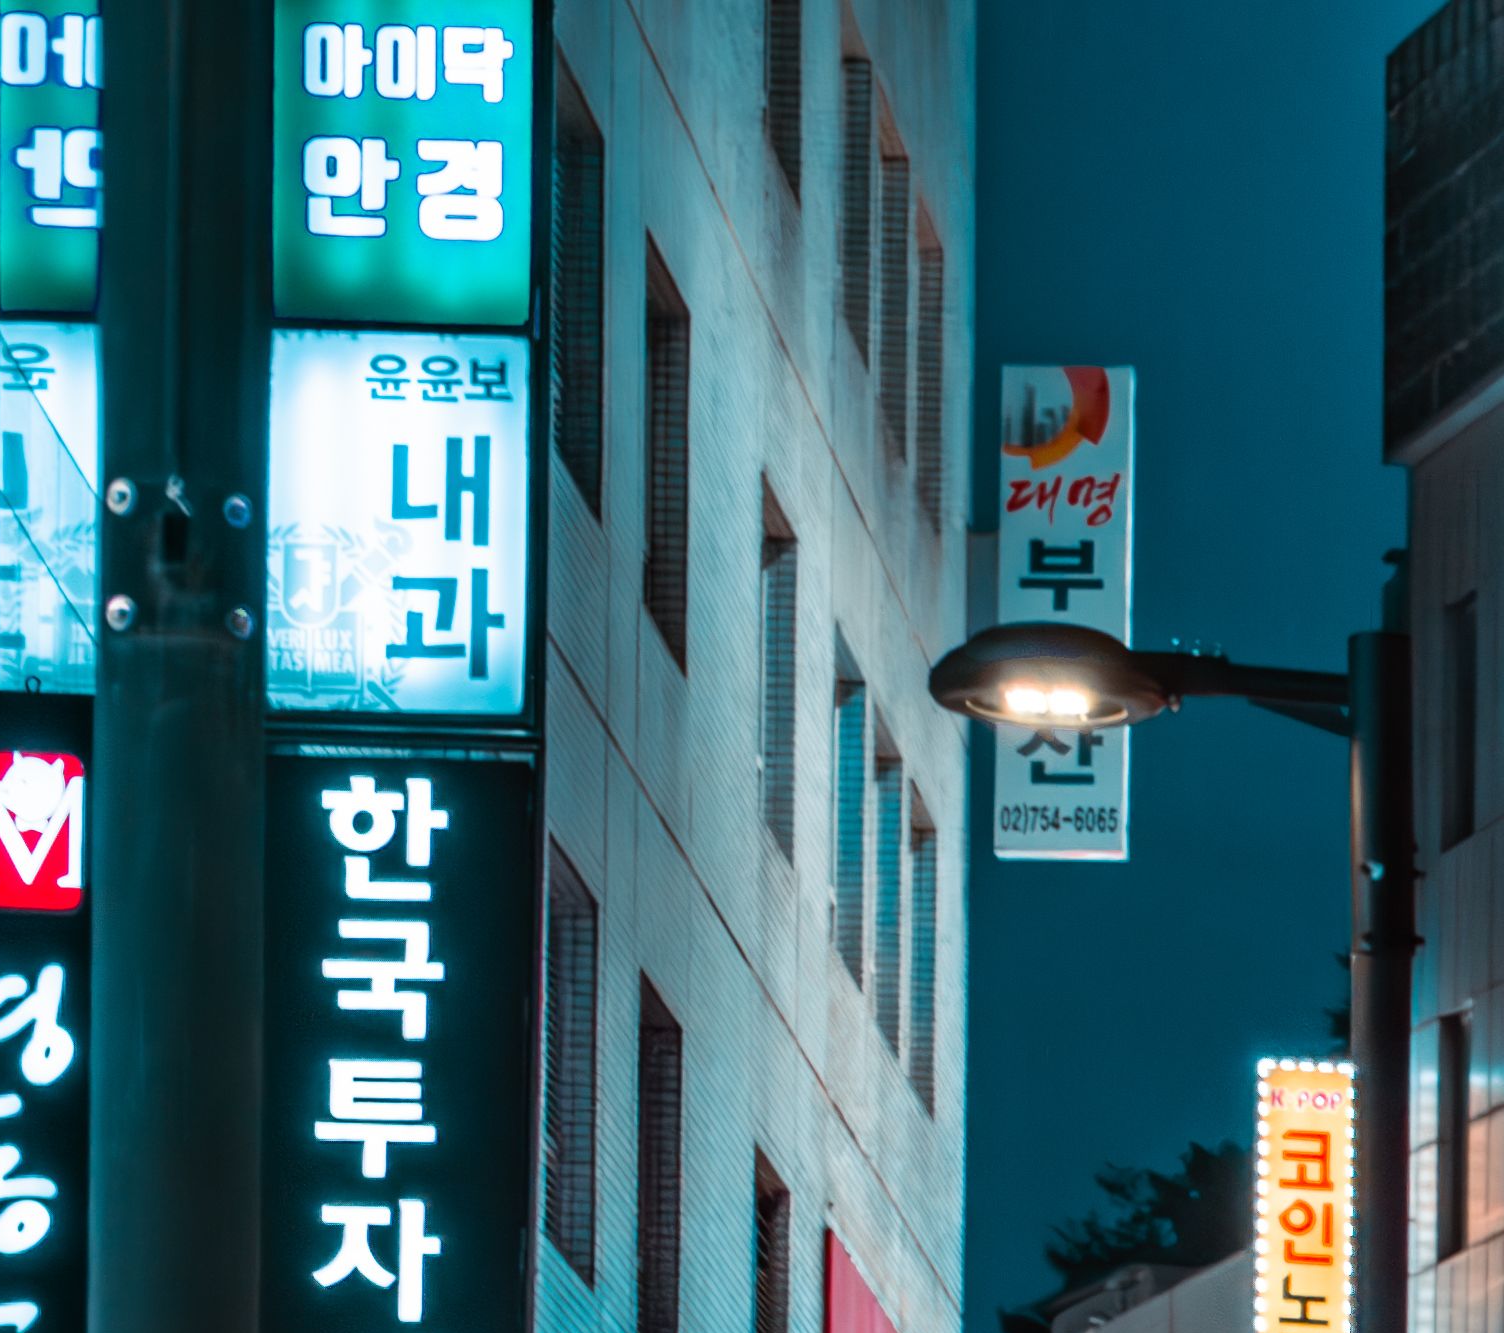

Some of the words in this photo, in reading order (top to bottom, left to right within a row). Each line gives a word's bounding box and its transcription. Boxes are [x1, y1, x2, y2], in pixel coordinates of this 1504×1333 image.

[301, 21, 514, 104] 아이닥
[302, 134, 506, 242] 안경
[366, 353, 512, 402] 윤윤보
[386, 435, 506, 681] 내과
[1016, 539, 1105, 786] 부산
[999, 803, 1119, 836] 02)754-6065
